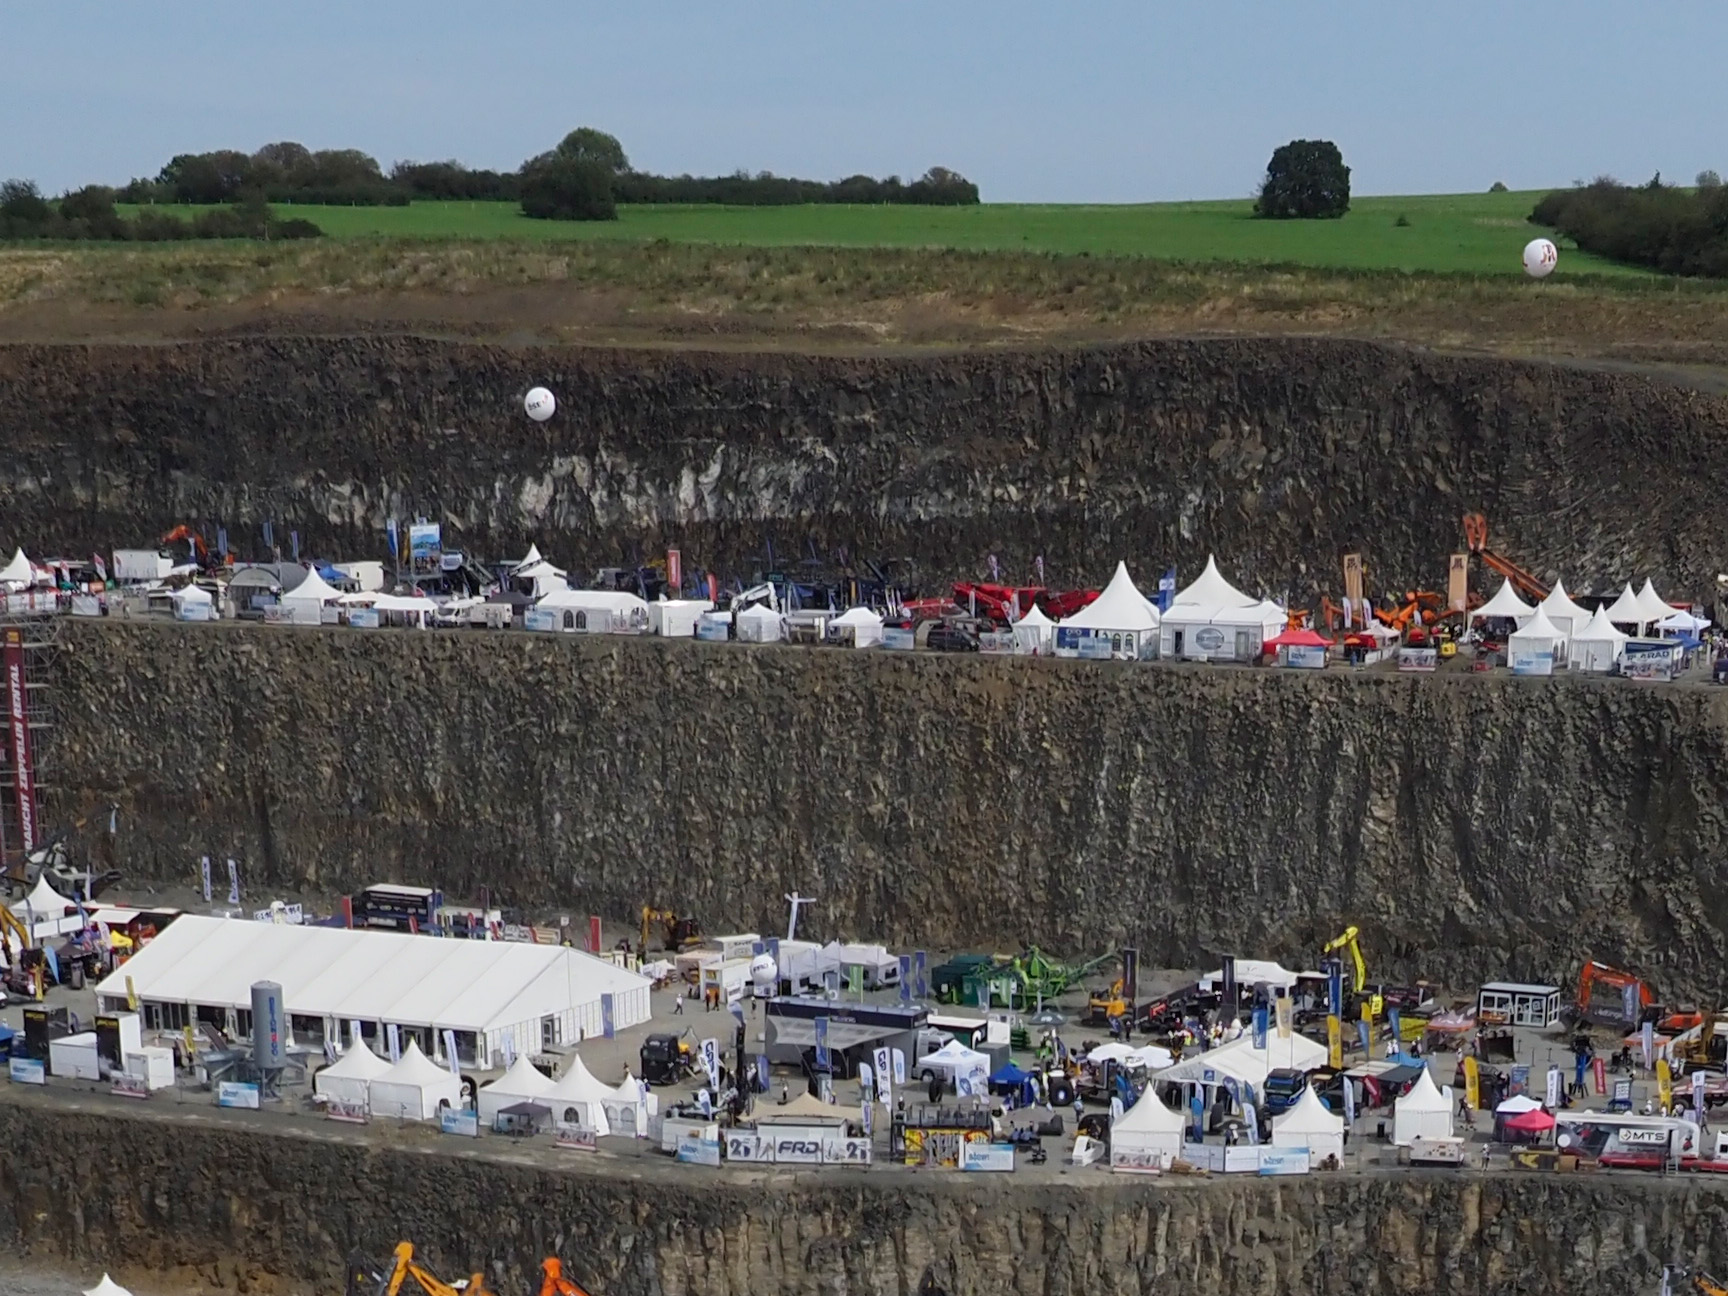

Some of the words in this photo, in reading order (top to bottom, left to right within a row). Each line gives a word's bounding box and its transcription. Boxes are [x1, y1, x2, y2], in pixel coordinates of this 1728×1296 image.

[9, 662, 24, 718] RENTAL
[13, 719, 29, 790] ZEPPELIN
[778, 1141, 819, 1154] FRD
[1632, 1131, 1665, 1141] MTS
